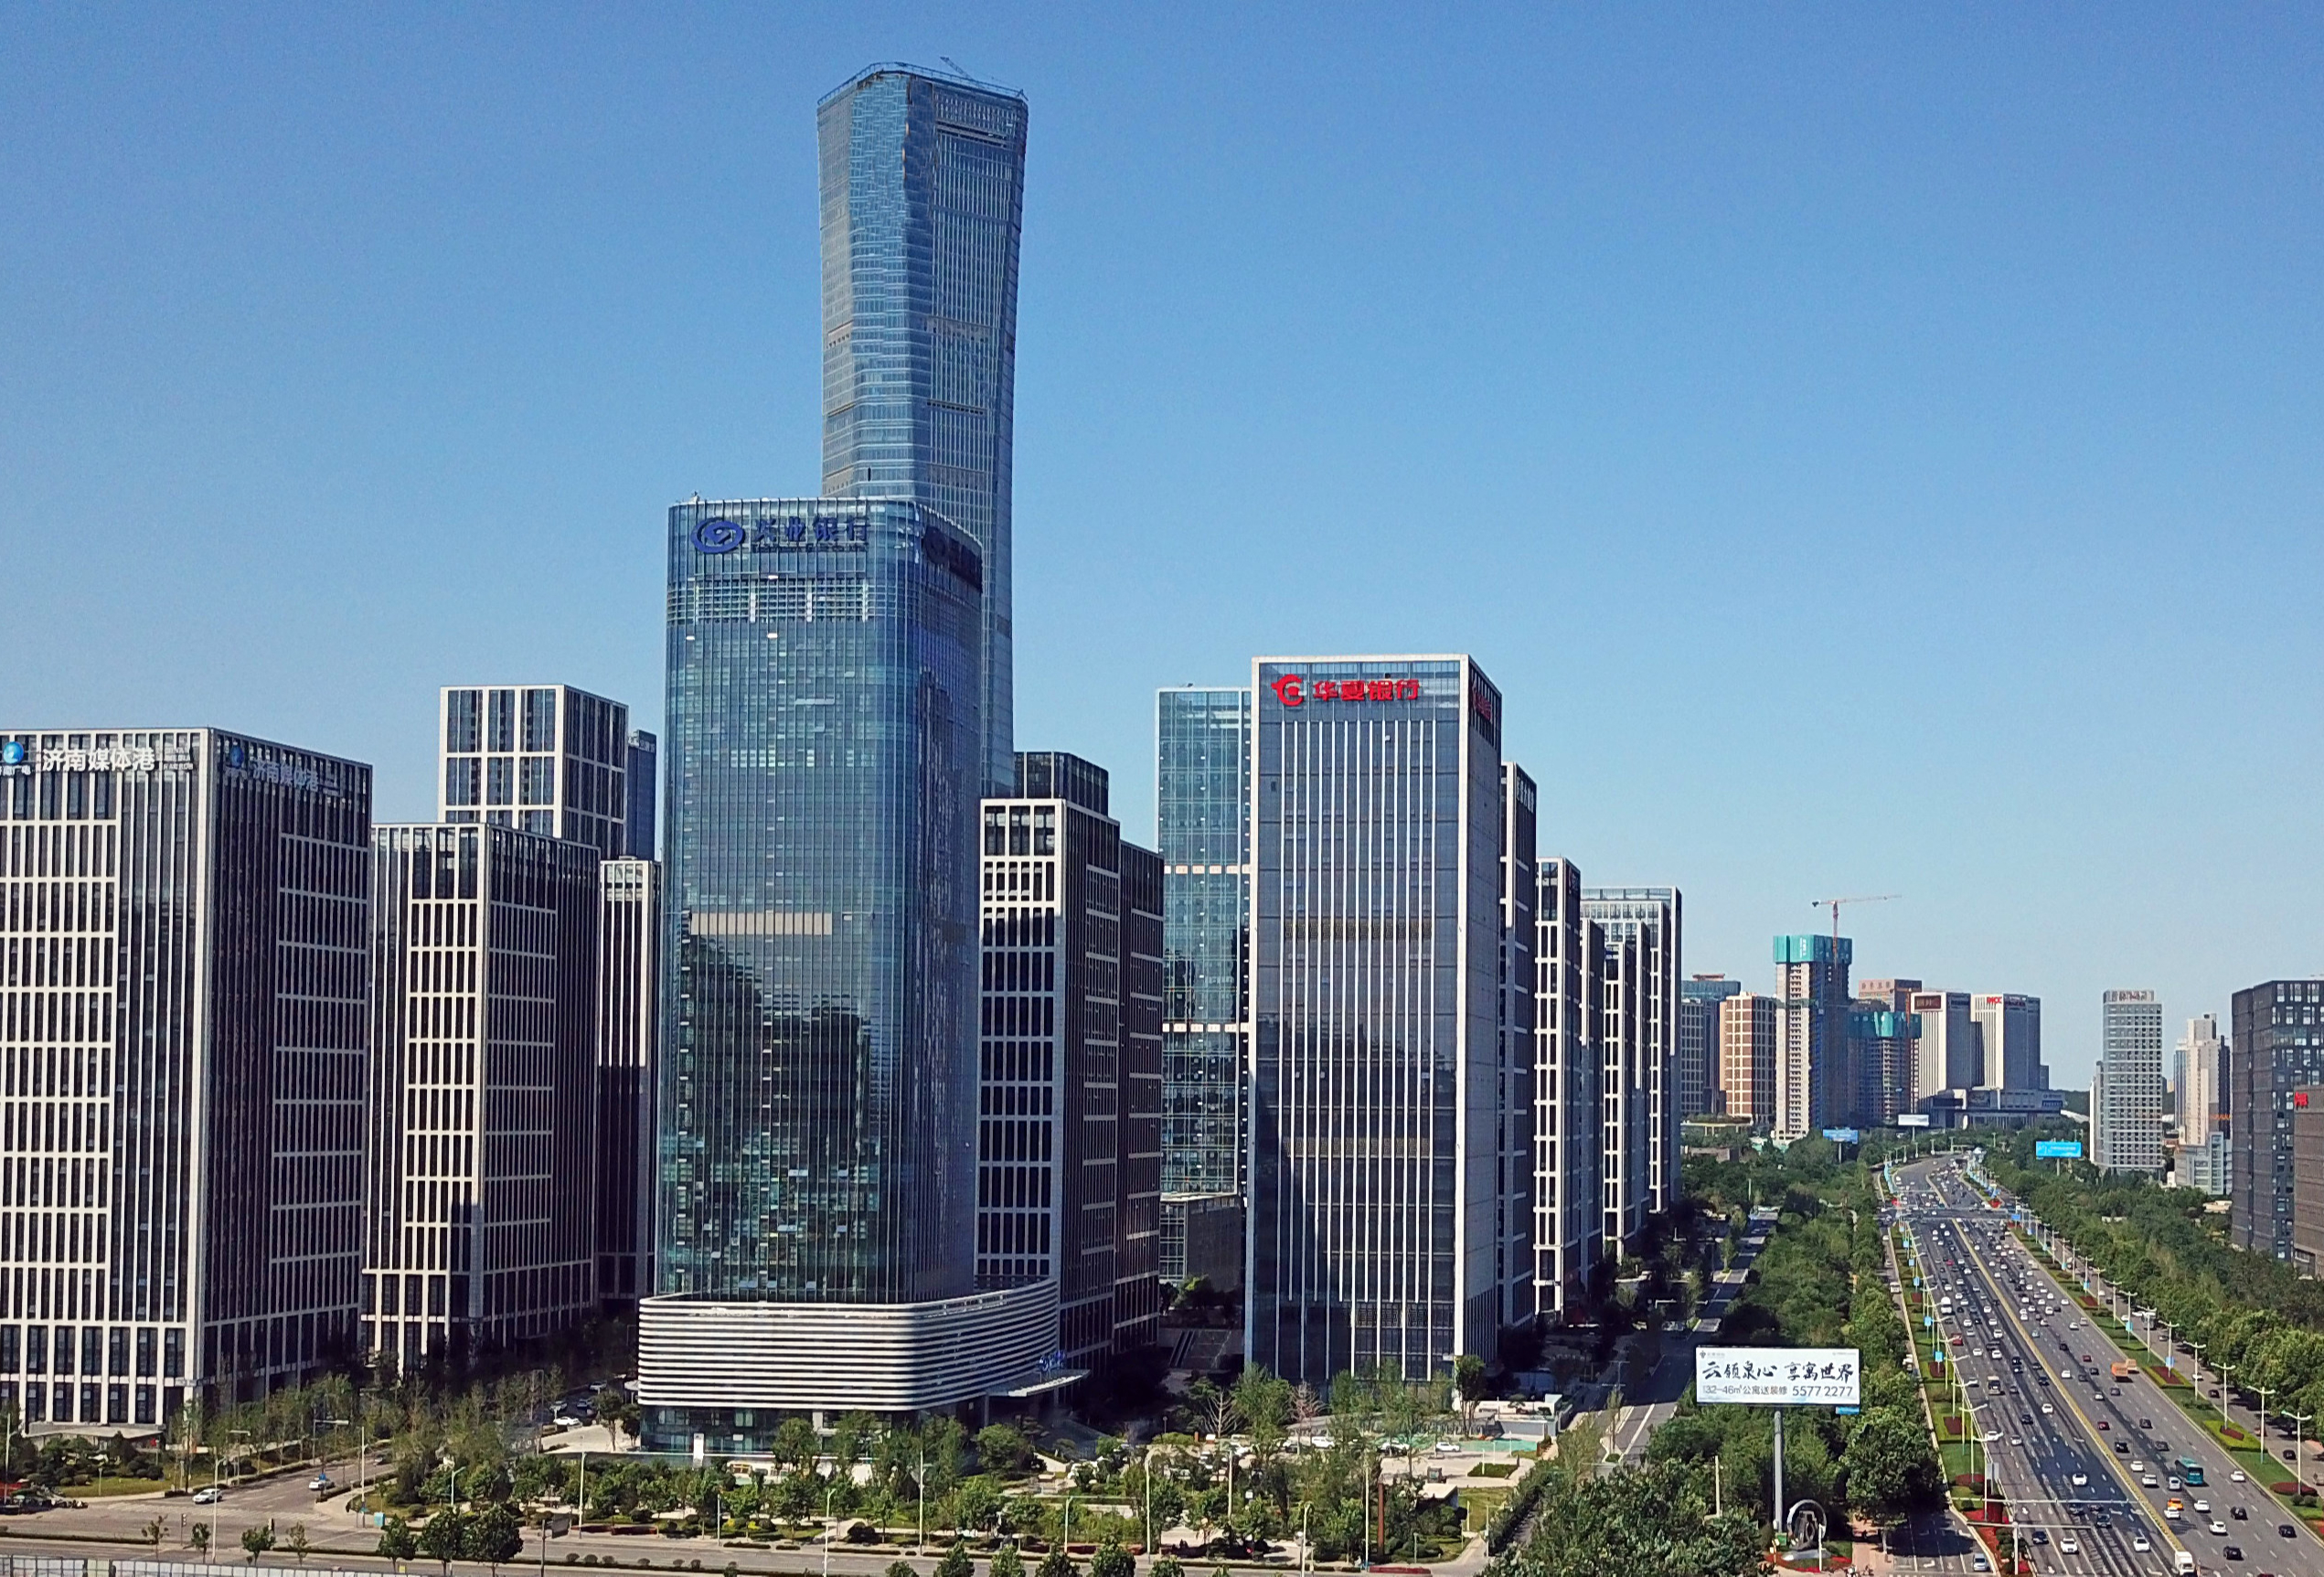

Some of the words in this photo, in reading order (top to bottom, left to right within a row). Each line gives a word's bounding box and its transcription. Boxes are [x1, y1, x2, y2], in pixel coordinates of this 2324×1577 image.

[752, 517, 870, 542] 兴业银行
[1313, 679, 1420, 702] 华夏银行
[42, 748, 155, 772] 济南媒体港
